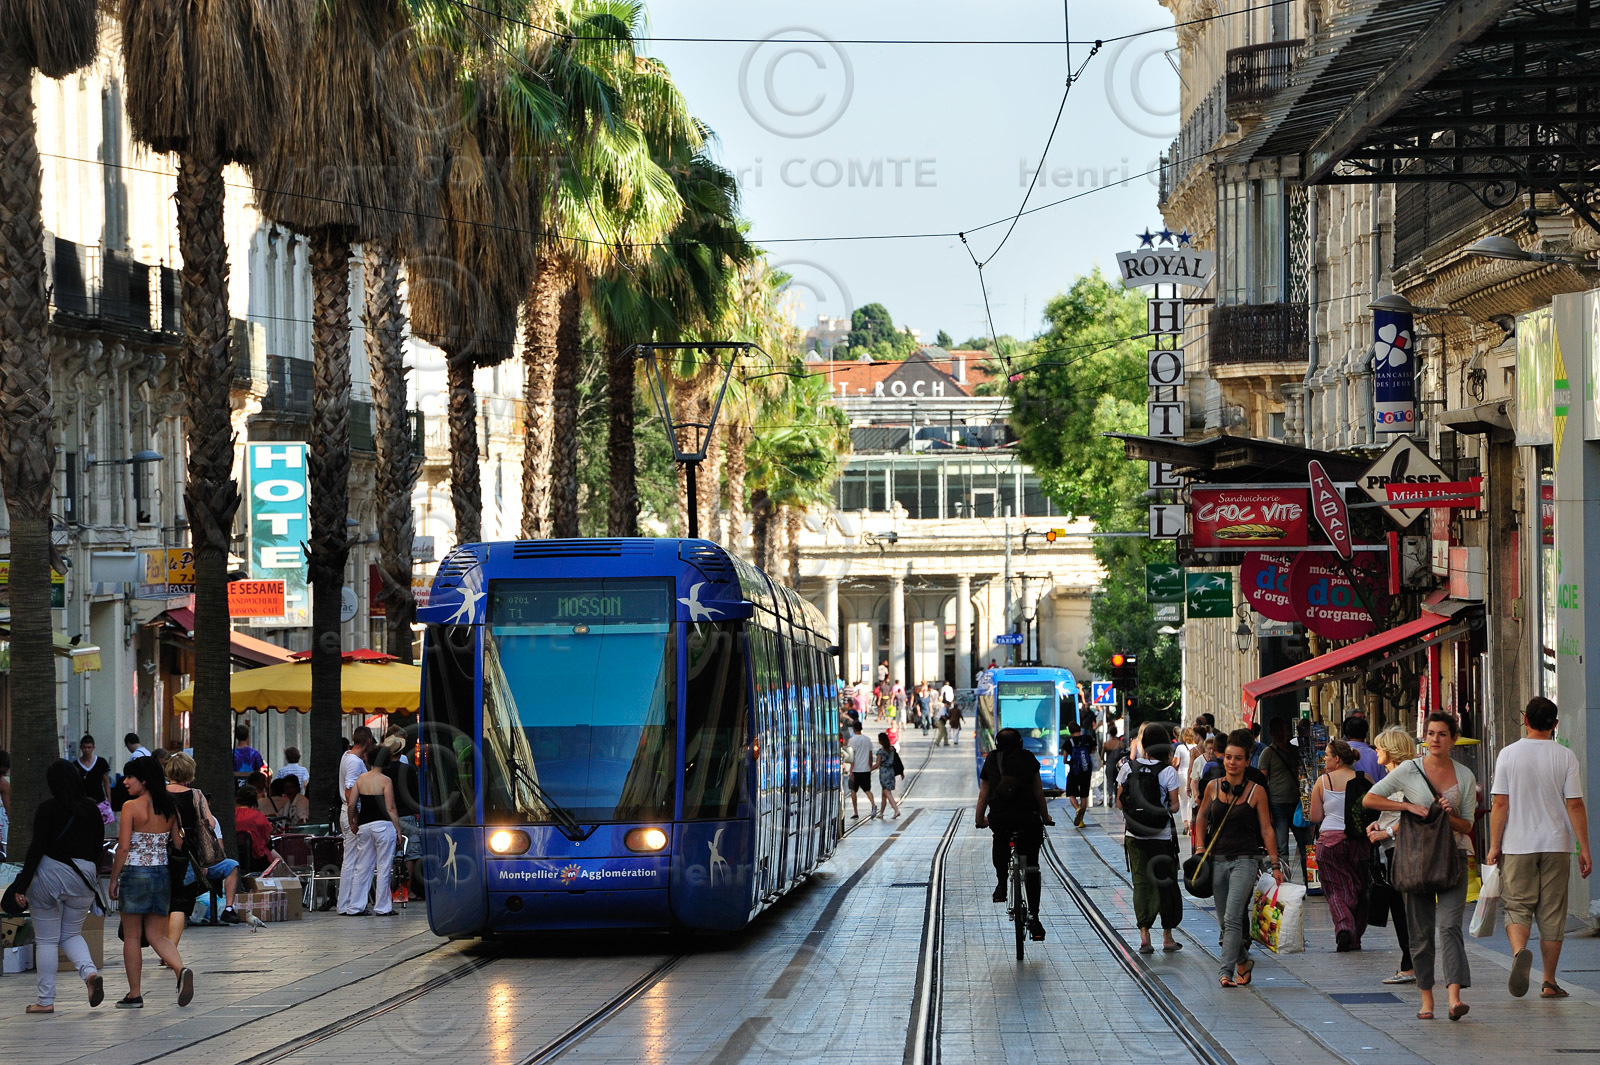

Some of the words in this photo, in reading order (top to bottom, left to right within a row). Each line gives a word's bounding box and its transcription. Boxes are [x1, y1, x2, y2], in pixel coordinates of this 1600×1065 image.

[1123, 255, 1207, 279] ROYAL
[1150, 301, 1181, 537] HOTEL
[1376, 409, 1413, 424] LOTO
[1218, 492, 1281, 503] Sandwicherie
[1391, 490, 1423, 501] Midi
[1197, 502, 1256, 522] CROC
[1260, 502, 1303, 522] VITE
[1314, 476, 1346, 542] TABAC
[169, 584, 192, 594] FAST
[240, 583, 284, 594] SESAME
[508, 597, 529, 605] 0701
[558, 597, 622, 617] MOSSON
[509, 608, 523, 619] T1
[1306, 606, 1373, 622] d'organes
[499, 870, 559, 881] Montpellier
[580, 868, 657, 880] Agglomération
